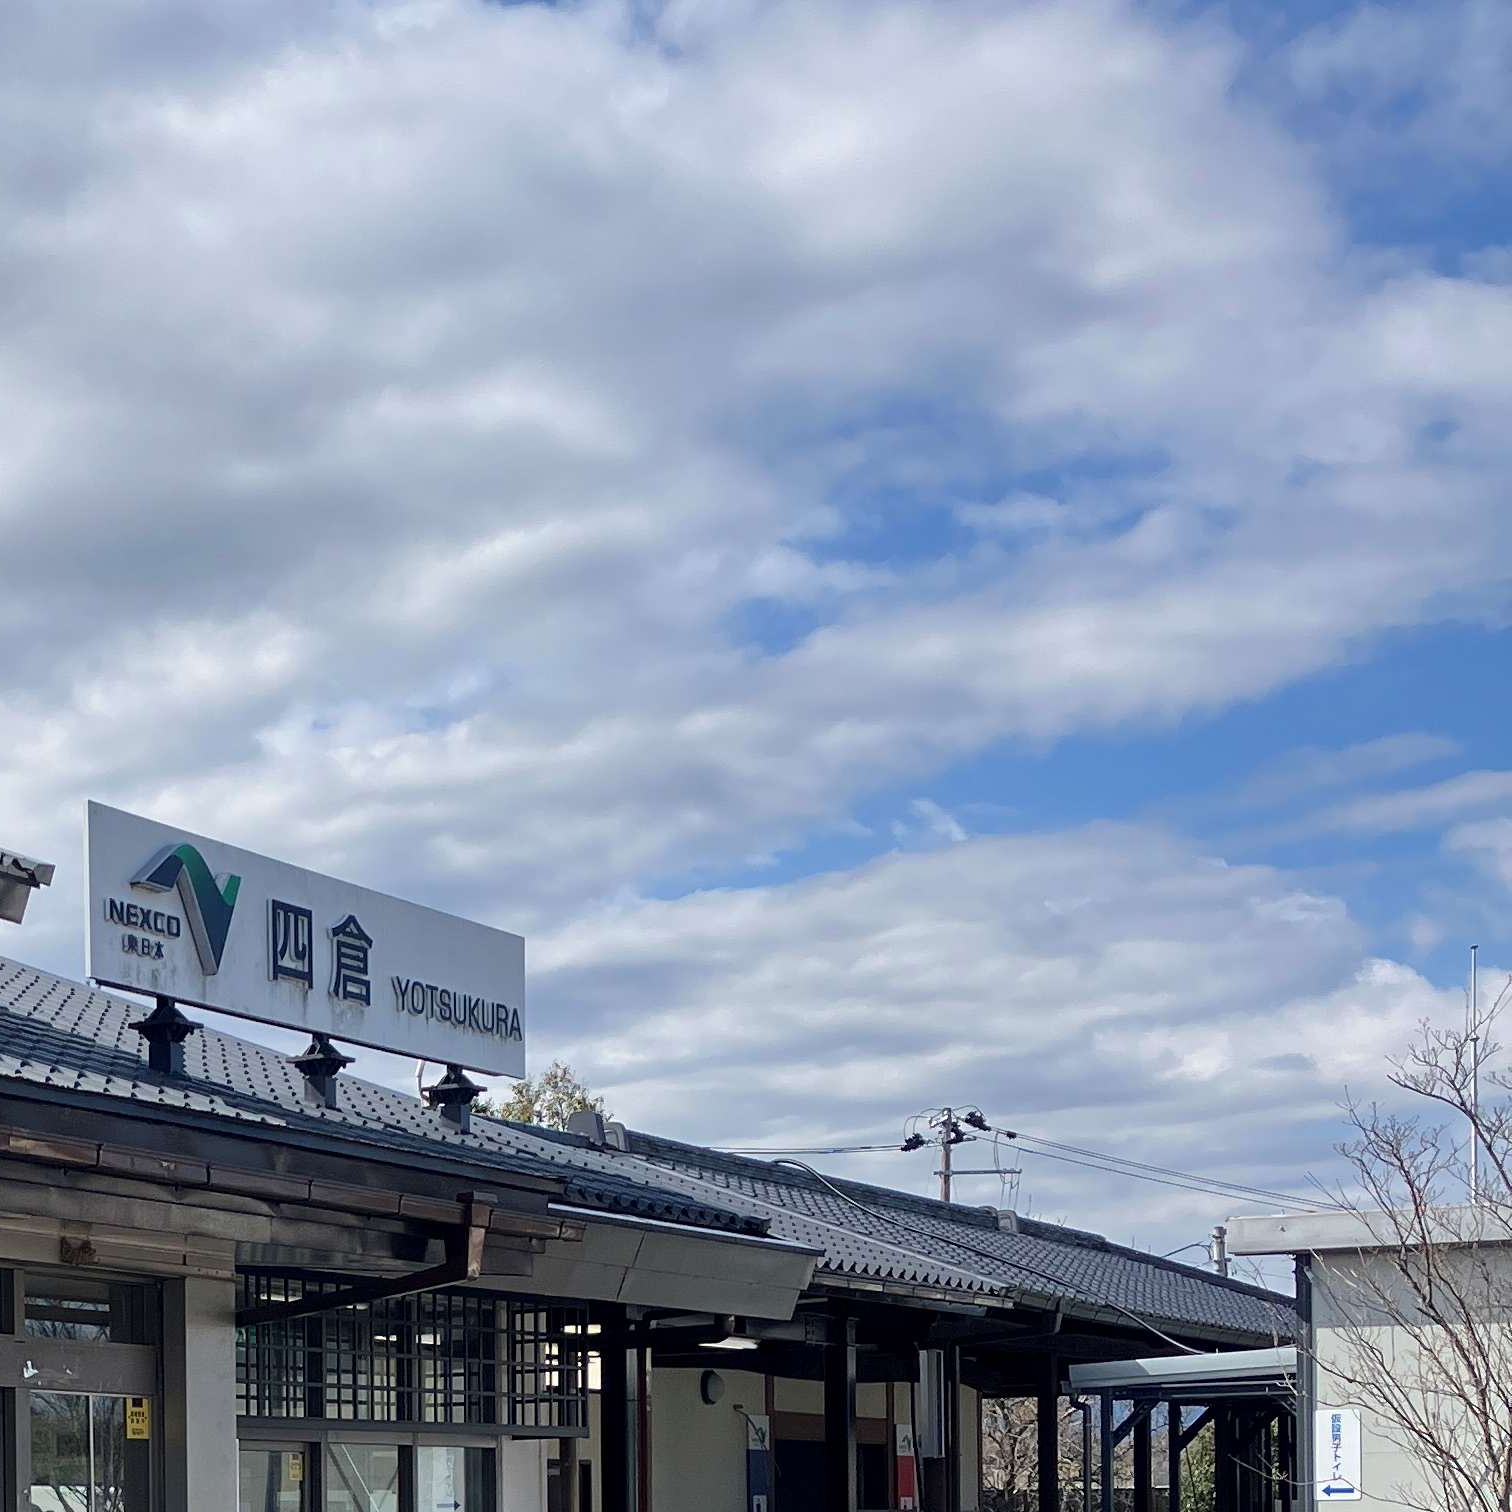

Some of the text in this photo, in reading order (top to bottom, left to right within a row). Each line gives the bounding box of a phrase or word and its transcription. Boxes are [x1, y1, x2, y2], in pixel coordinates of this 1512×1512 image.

[107, 897, 181, 938] NEXCO
[124, 933, 165, 960] 東日本
[270, 898, 374, 1007] 四倉
[393, 975, 523, 1042] YOTSUKURA
